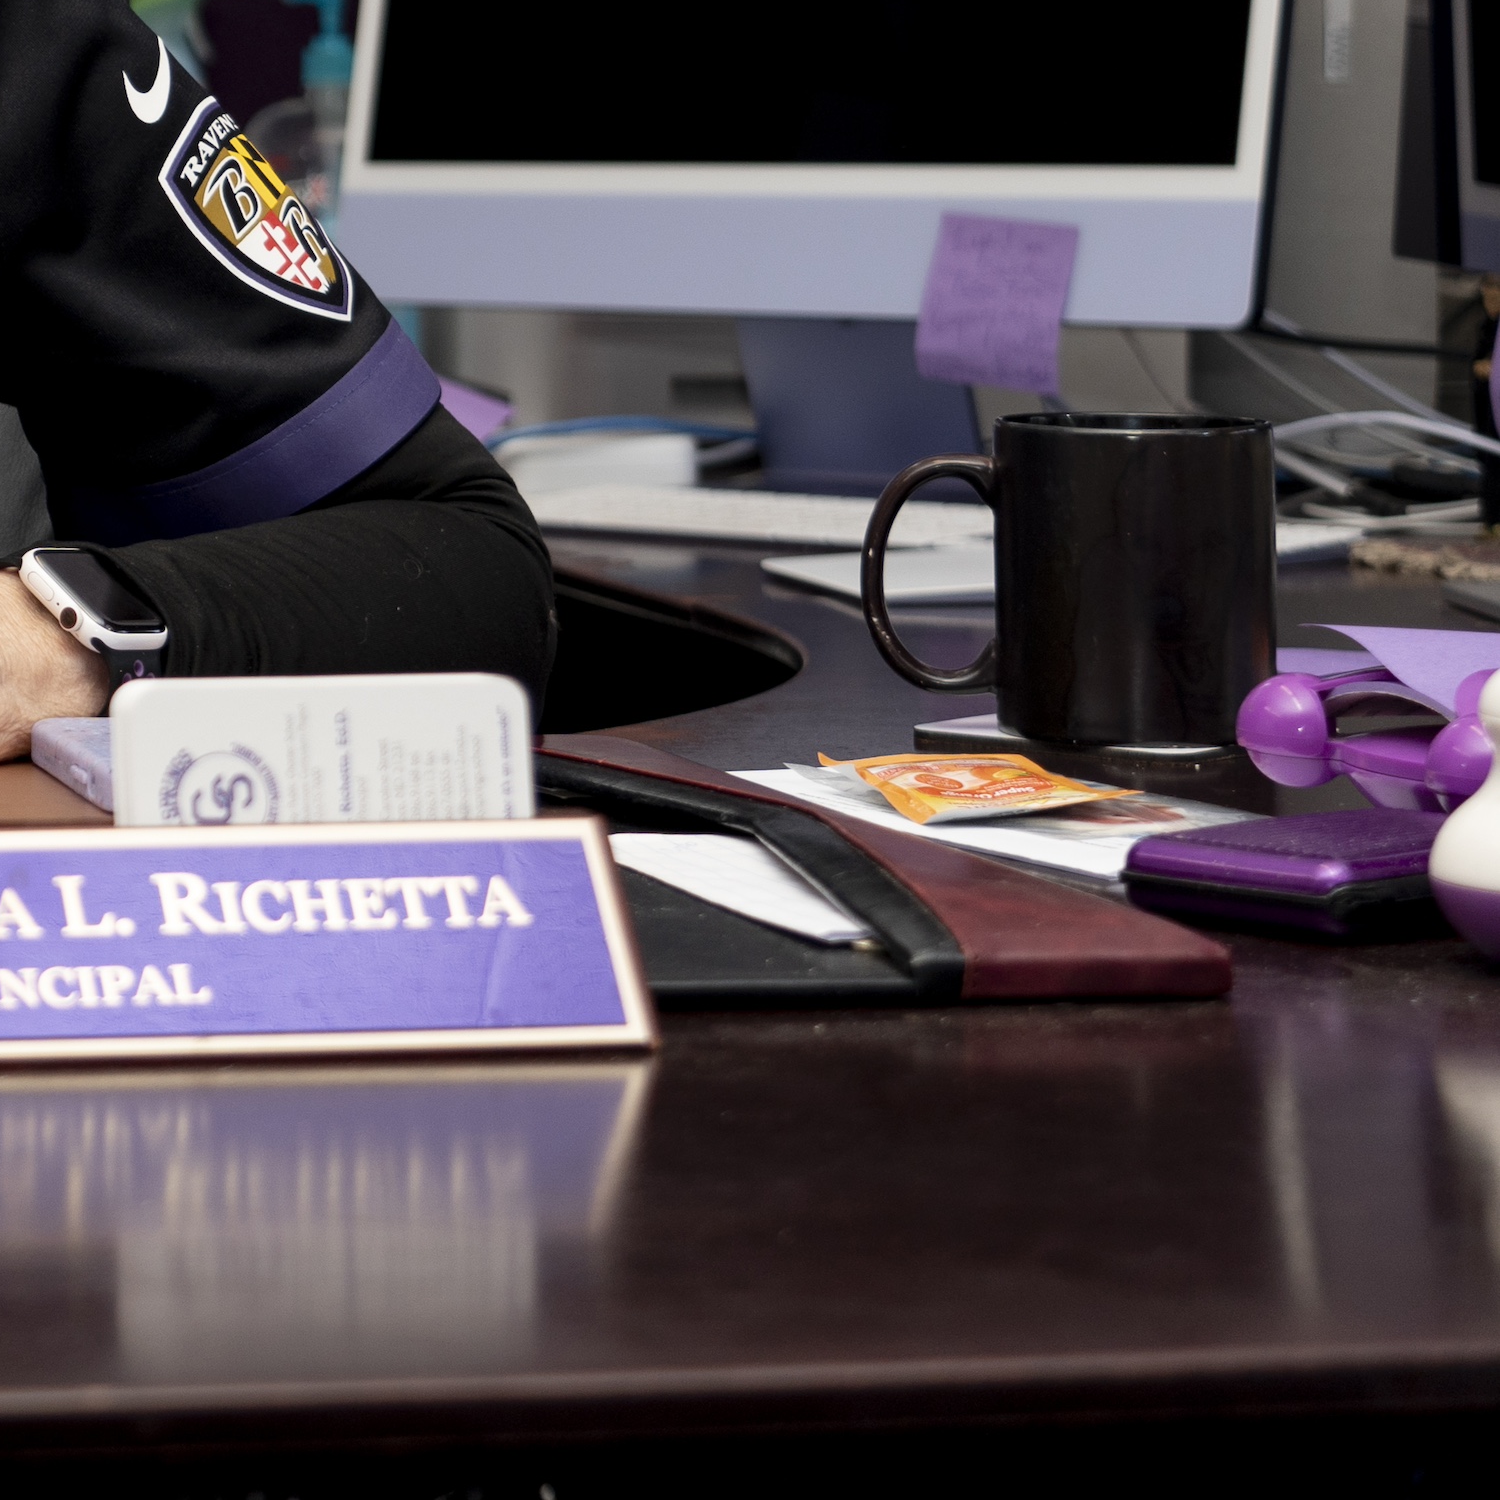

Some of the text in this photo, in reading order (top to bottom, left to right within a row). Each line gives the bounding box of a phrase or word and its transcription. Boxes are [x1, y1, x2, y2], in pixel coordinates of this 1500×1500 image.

[993, 785, 1036, 799] Super
[53, 874, 134, 940] L.
[149, 870, 531, 937] RICHETTA
